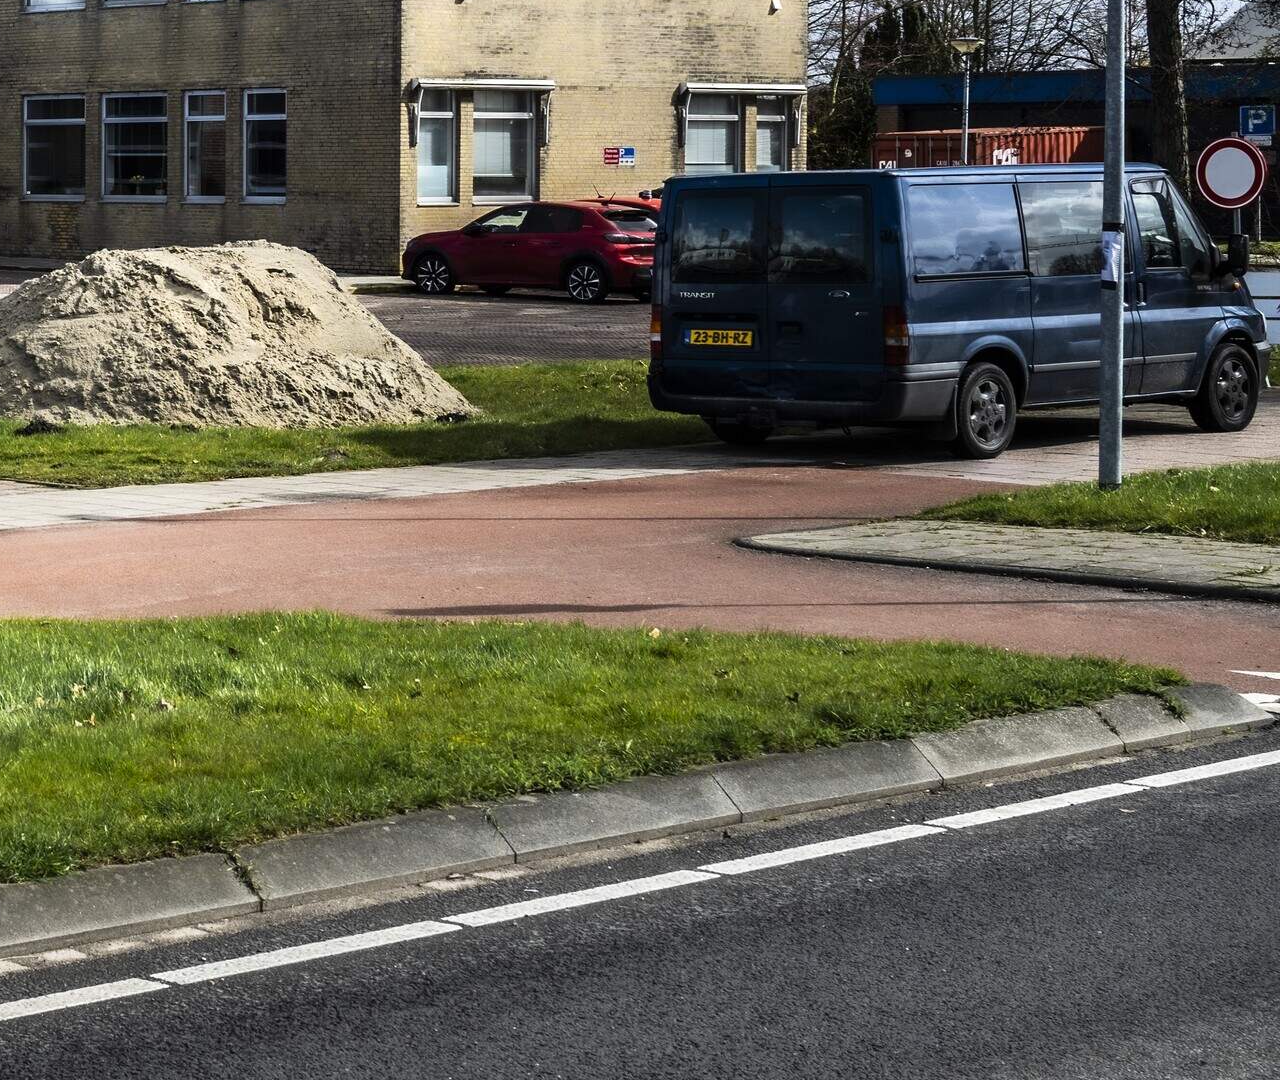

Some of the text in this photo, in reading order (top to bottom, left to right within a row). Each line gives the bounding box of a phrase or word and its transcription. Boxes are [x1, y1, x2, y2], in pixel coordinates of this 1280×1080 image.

[1249, 110, 1266, 132] P
[680, 291, 715, 299] TRANSIT
[693, 331, 748, 344] 23-BH-RZ
